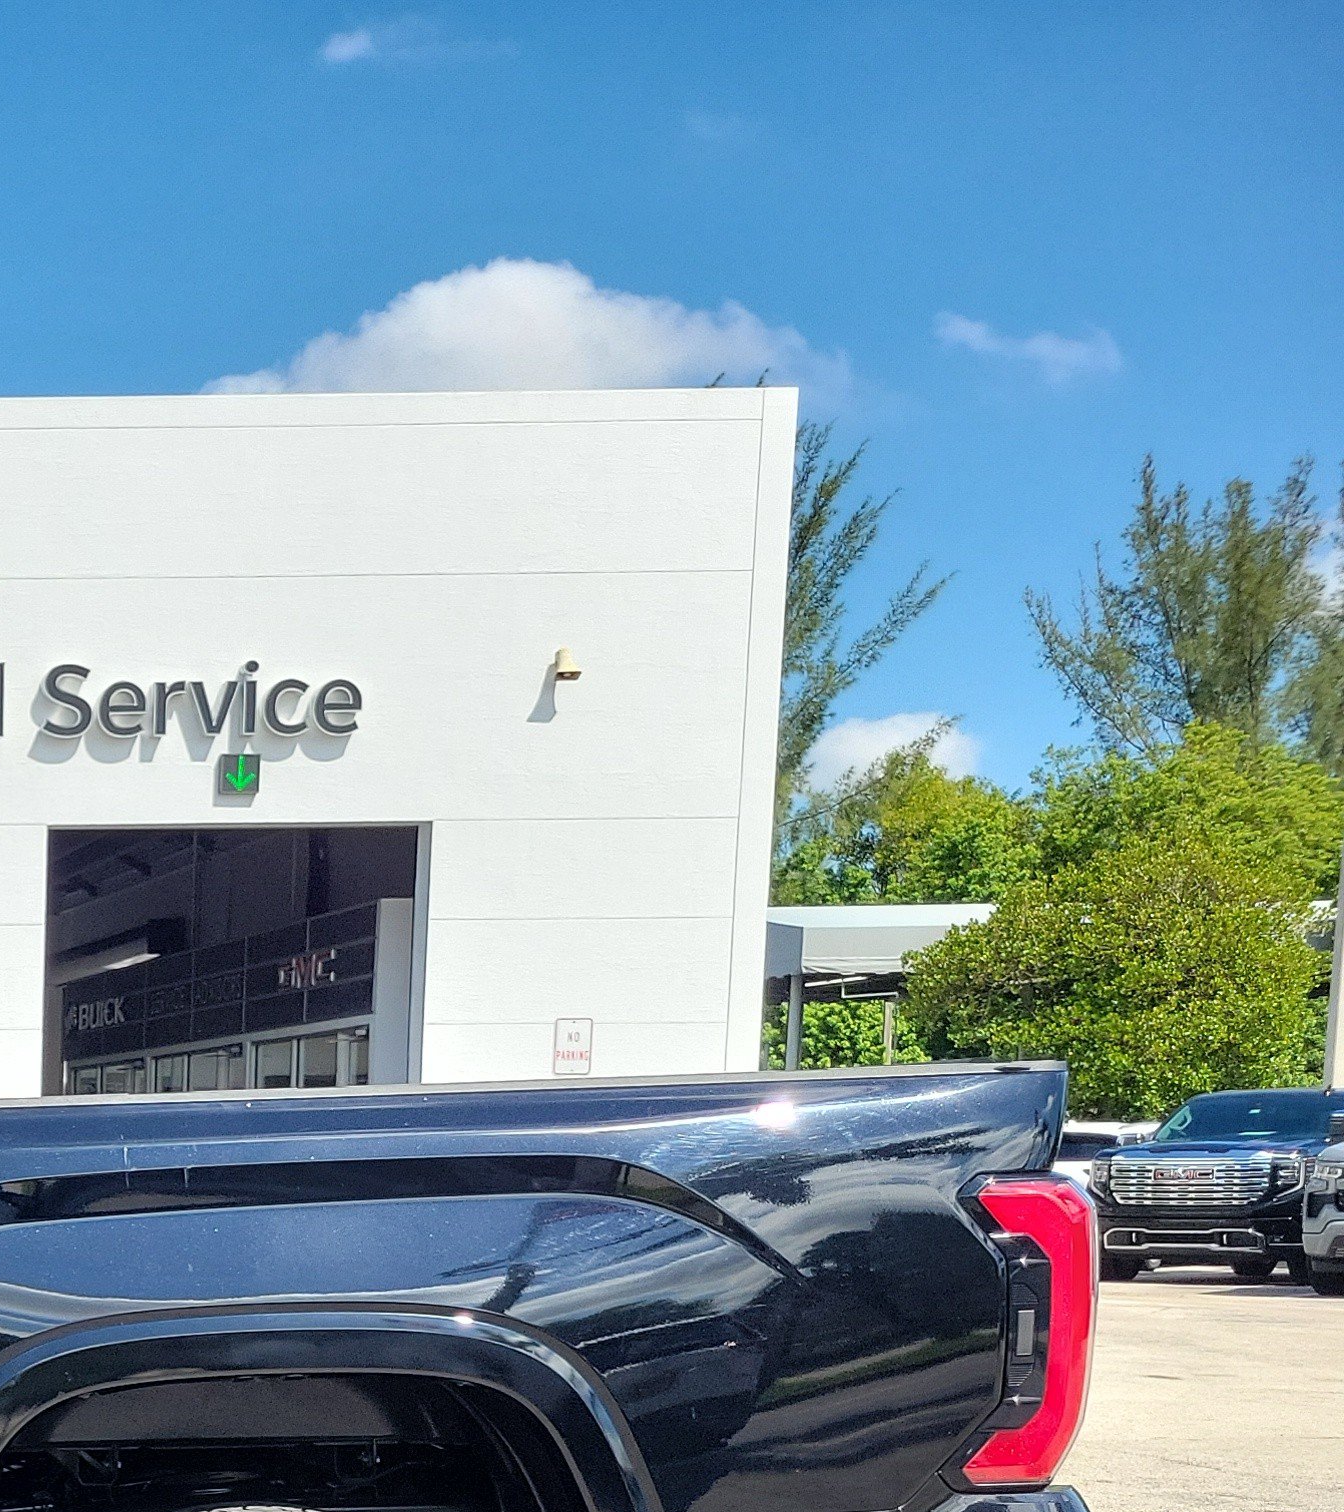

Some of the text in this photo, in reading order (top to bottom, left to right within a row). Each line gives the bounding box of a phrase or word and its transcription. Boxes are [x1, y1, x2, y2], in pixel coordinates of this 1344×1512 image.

[42, 659, 363, 740] Service
[278, 948, 337, 990] GMC
[77, 995, 127, 1031] BUICK
[567, 1031, 581, 1043] NO
[555, 1050, 588, 1061] PARKING
[1155, 1168, 1214, 1181] GMC
